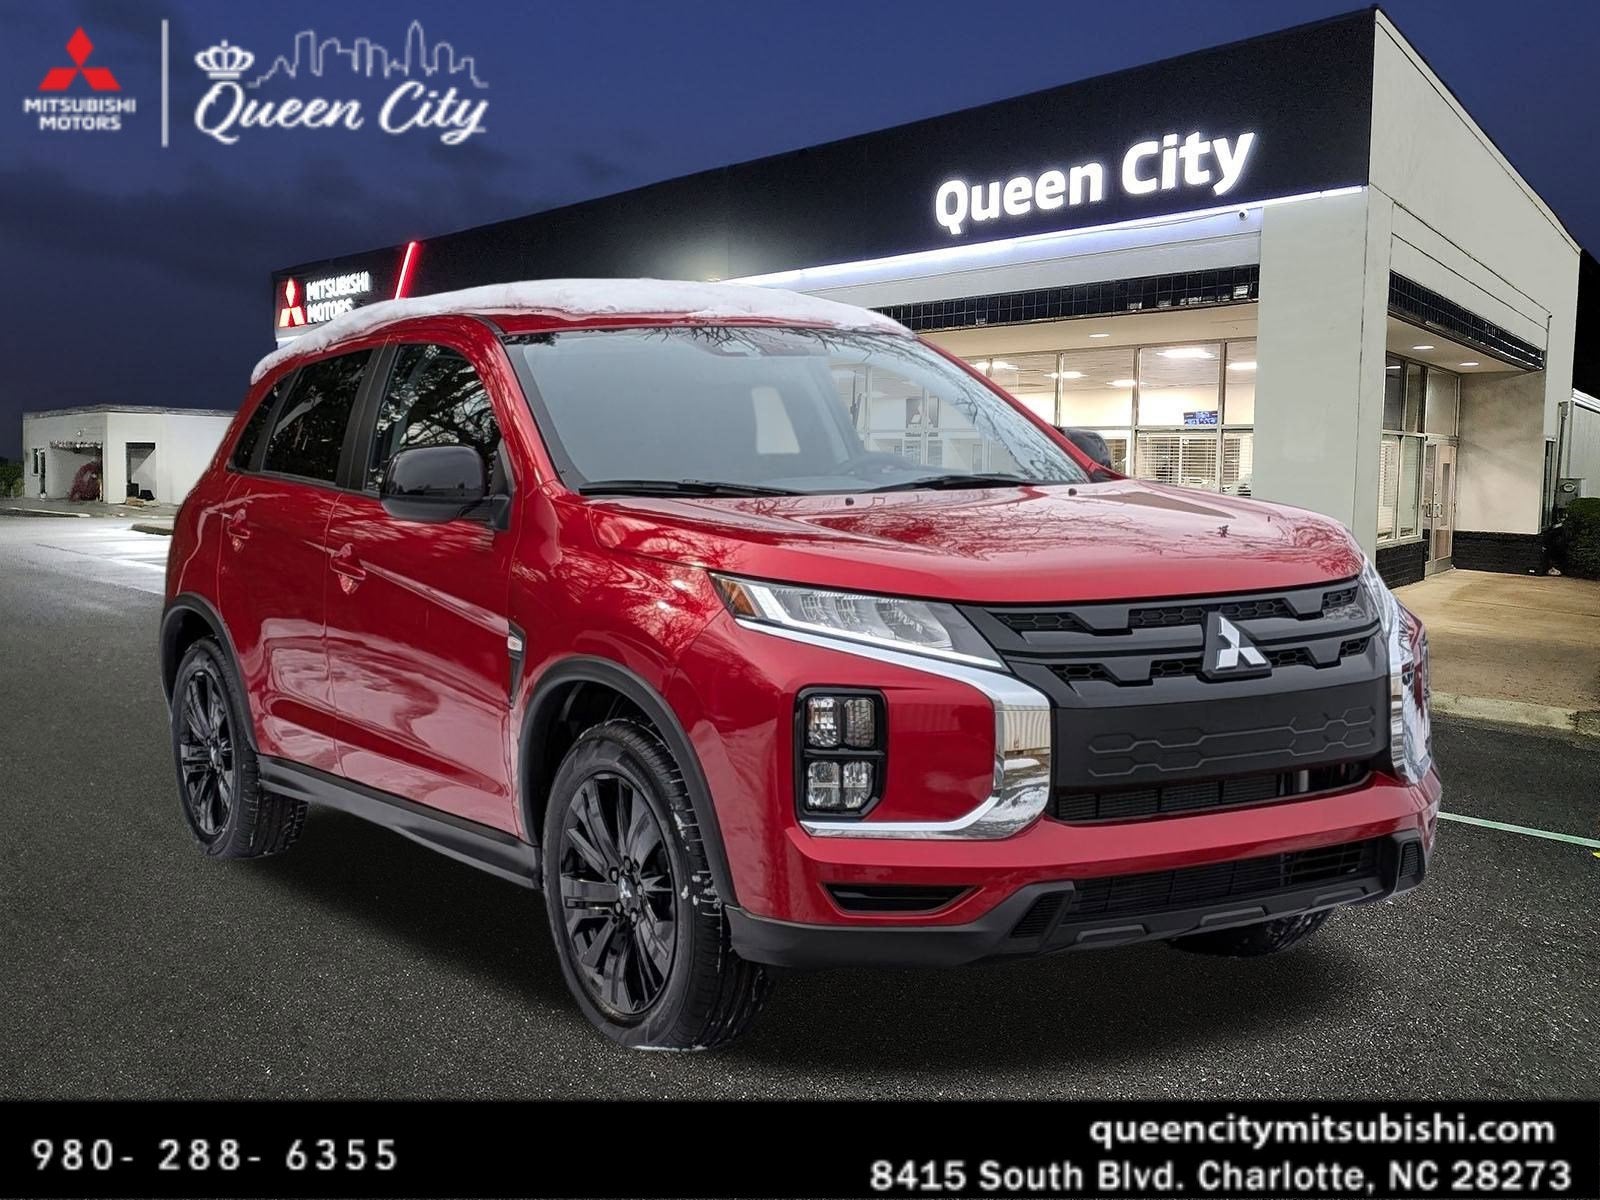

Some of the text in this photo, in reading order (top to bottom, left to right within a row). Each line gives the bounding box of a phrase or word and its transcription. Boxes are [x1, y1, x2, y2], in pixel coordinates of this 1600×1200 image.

[934, 131, 1256, 234] Queen City
[306, 270, 370, 302] MITSUBISHI
